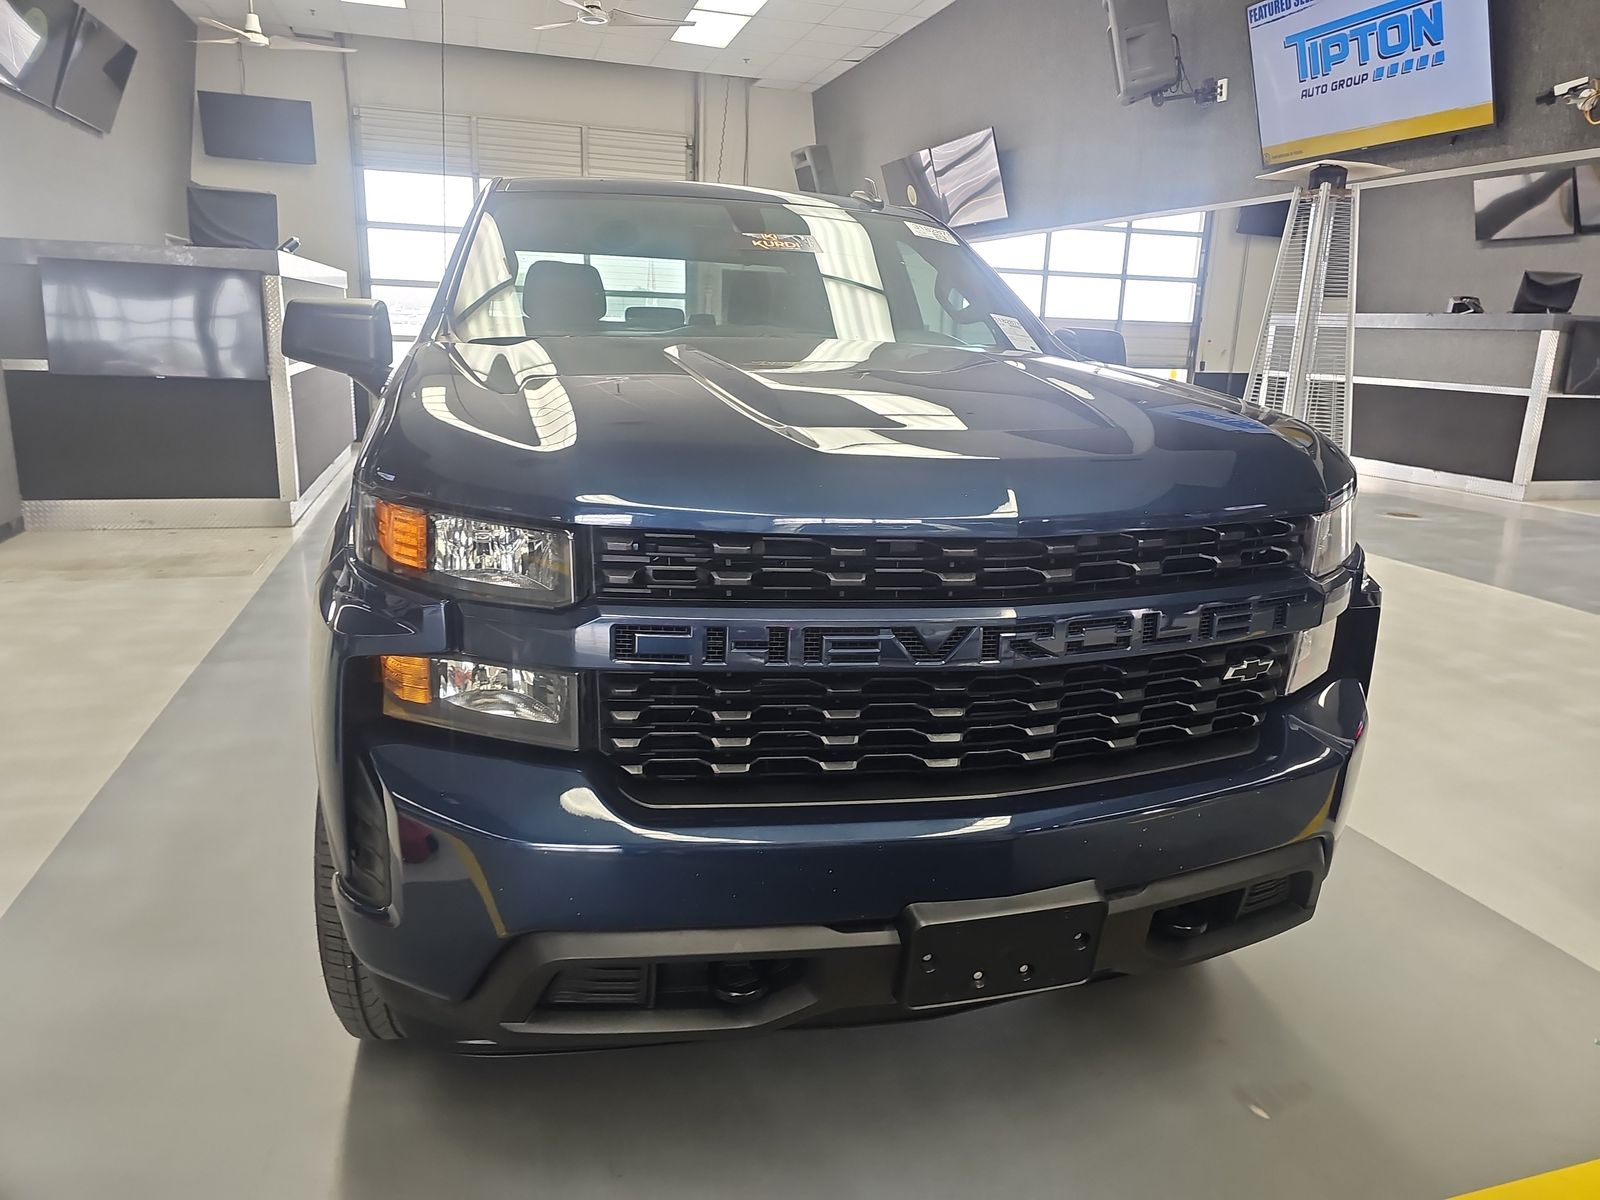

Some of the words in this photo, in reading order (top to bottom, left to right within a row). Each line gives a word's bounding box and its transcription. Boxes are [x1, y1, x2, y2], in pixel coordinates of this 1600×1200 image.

[1249, 0, 1292, 24] FEATURED
[1284, 0, 1445, 83] TIPTON
[1301, 83, 1328, 99] AUTO
[1330, 73, 1369, 92] GROUP
[608, 593, 1306, 667] CHEVROLET
